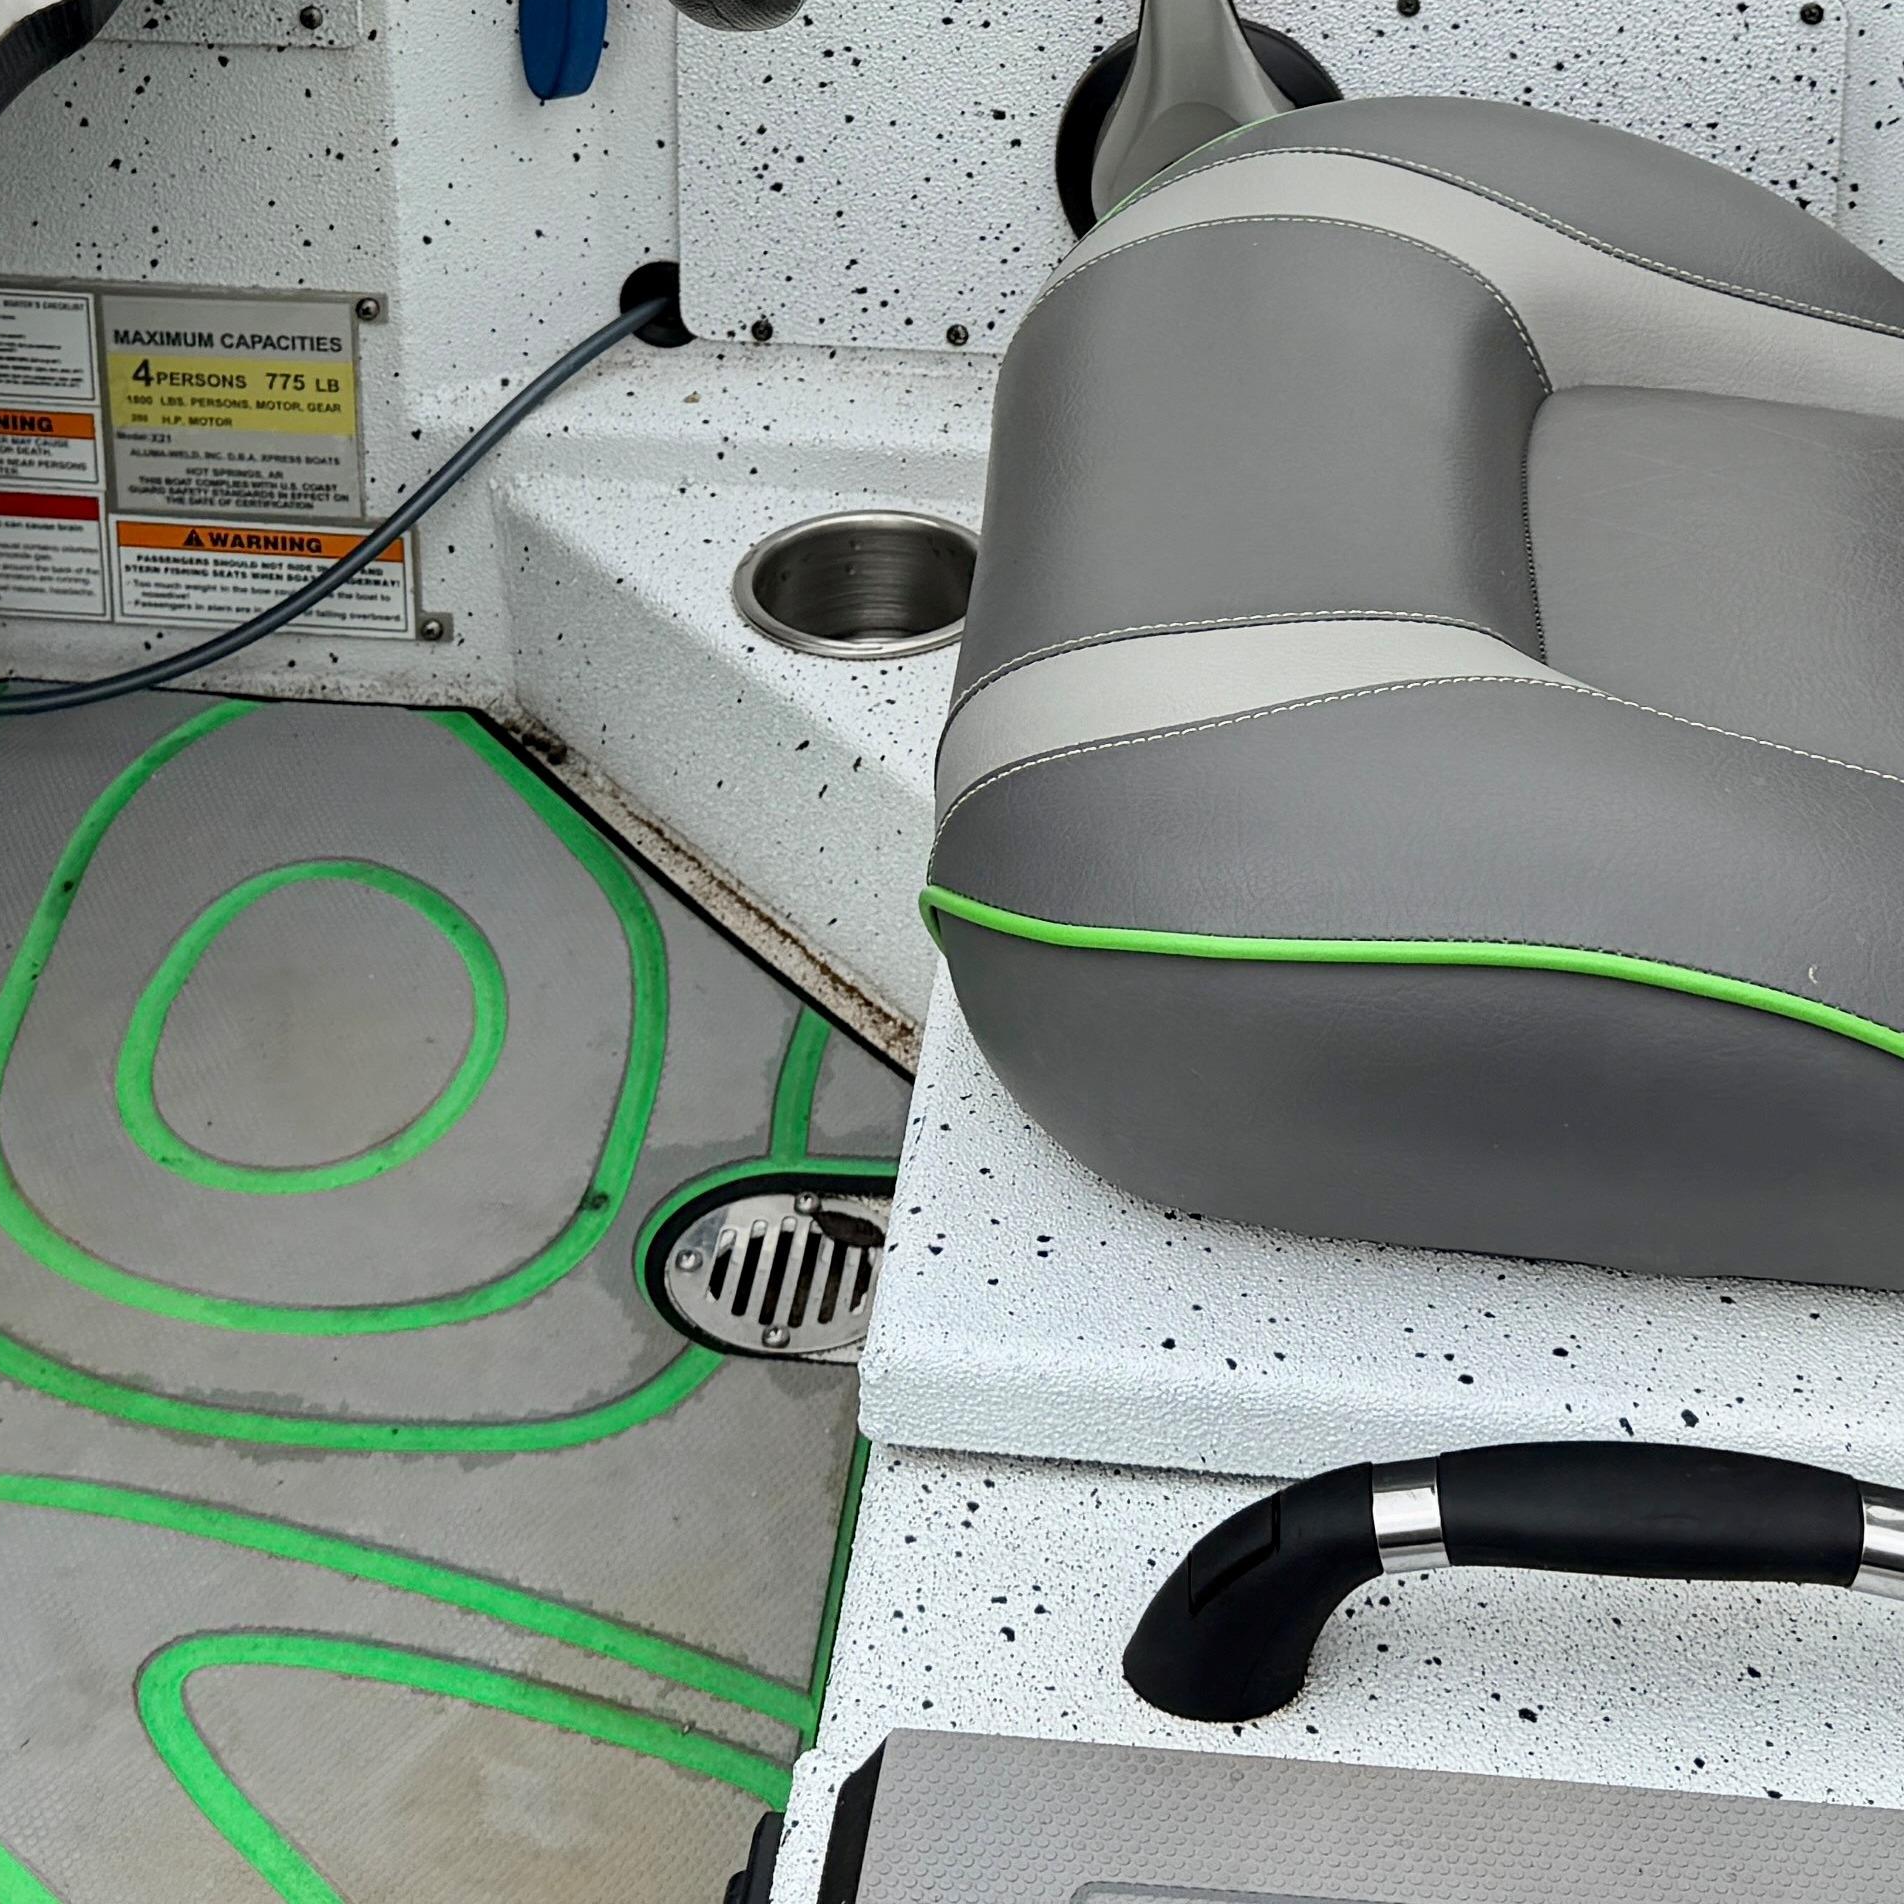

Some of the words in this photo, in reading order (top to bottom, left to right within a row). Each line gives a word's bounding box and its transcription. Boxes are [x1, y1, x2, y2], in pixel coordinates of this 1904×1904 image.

[114, 329, 214, 348] MAXIMUM
[220, 333, 343, 352] CAPACITIES
[132, 359, 154, 387] 4
[156, 371, 247, 389] PERSONS
[266, 373, 306, 391] 775
[315, 378, 339, 393] LB
[307, 402, 341, 412] GEAR
[189, 416, 232, 426] MOTOR
[11, 437, 32, 445] MAY
[35, 439, 68, 447] CAUSE
[38, 460, 87, 471] PERSONS
[261, 454, 302, 464] XPRESS
[305, 456, 341, 466] BOATS
[186, 467, 209, 476] HOT
[139, 476, 161, 485] THIS
[165, 477, 193, 486] BOAT
[195, 478, 248, 489] COMPLIES
[251, 481, 277, 490] WITH
[302, 482, 338, 492] COAST
[128, 485, 166, 495] GUARD
[169, 486, 209, 496] SAFETY
[212, 488, 274, 499] STANDARDS
[291, 491, 330, 501] EFFECT
[167, 497, 185, 505] THE
[189, 497, 215, 506] DATE
[218, 498, 232, 507] OF
[235, 499, 314, 510] CERTIFICATION
[208, 531, 322, 553] WARNING
[137, 554, 210, 566] PASSENGERS
[213, 557, 258, 570] SHOULD
[261, 560, 284, 570] NOT
[287, 562, 313, 572] RIDE
[125, 564, 160, 573] STERN
[164, 566, 209, 578] FISHING
[212, 568, 247, 579] SEATS
[252, 571, 284, 581] WHEN
[232, 585, 248, 593] the
[134, 599, 192, 612] Passengers
